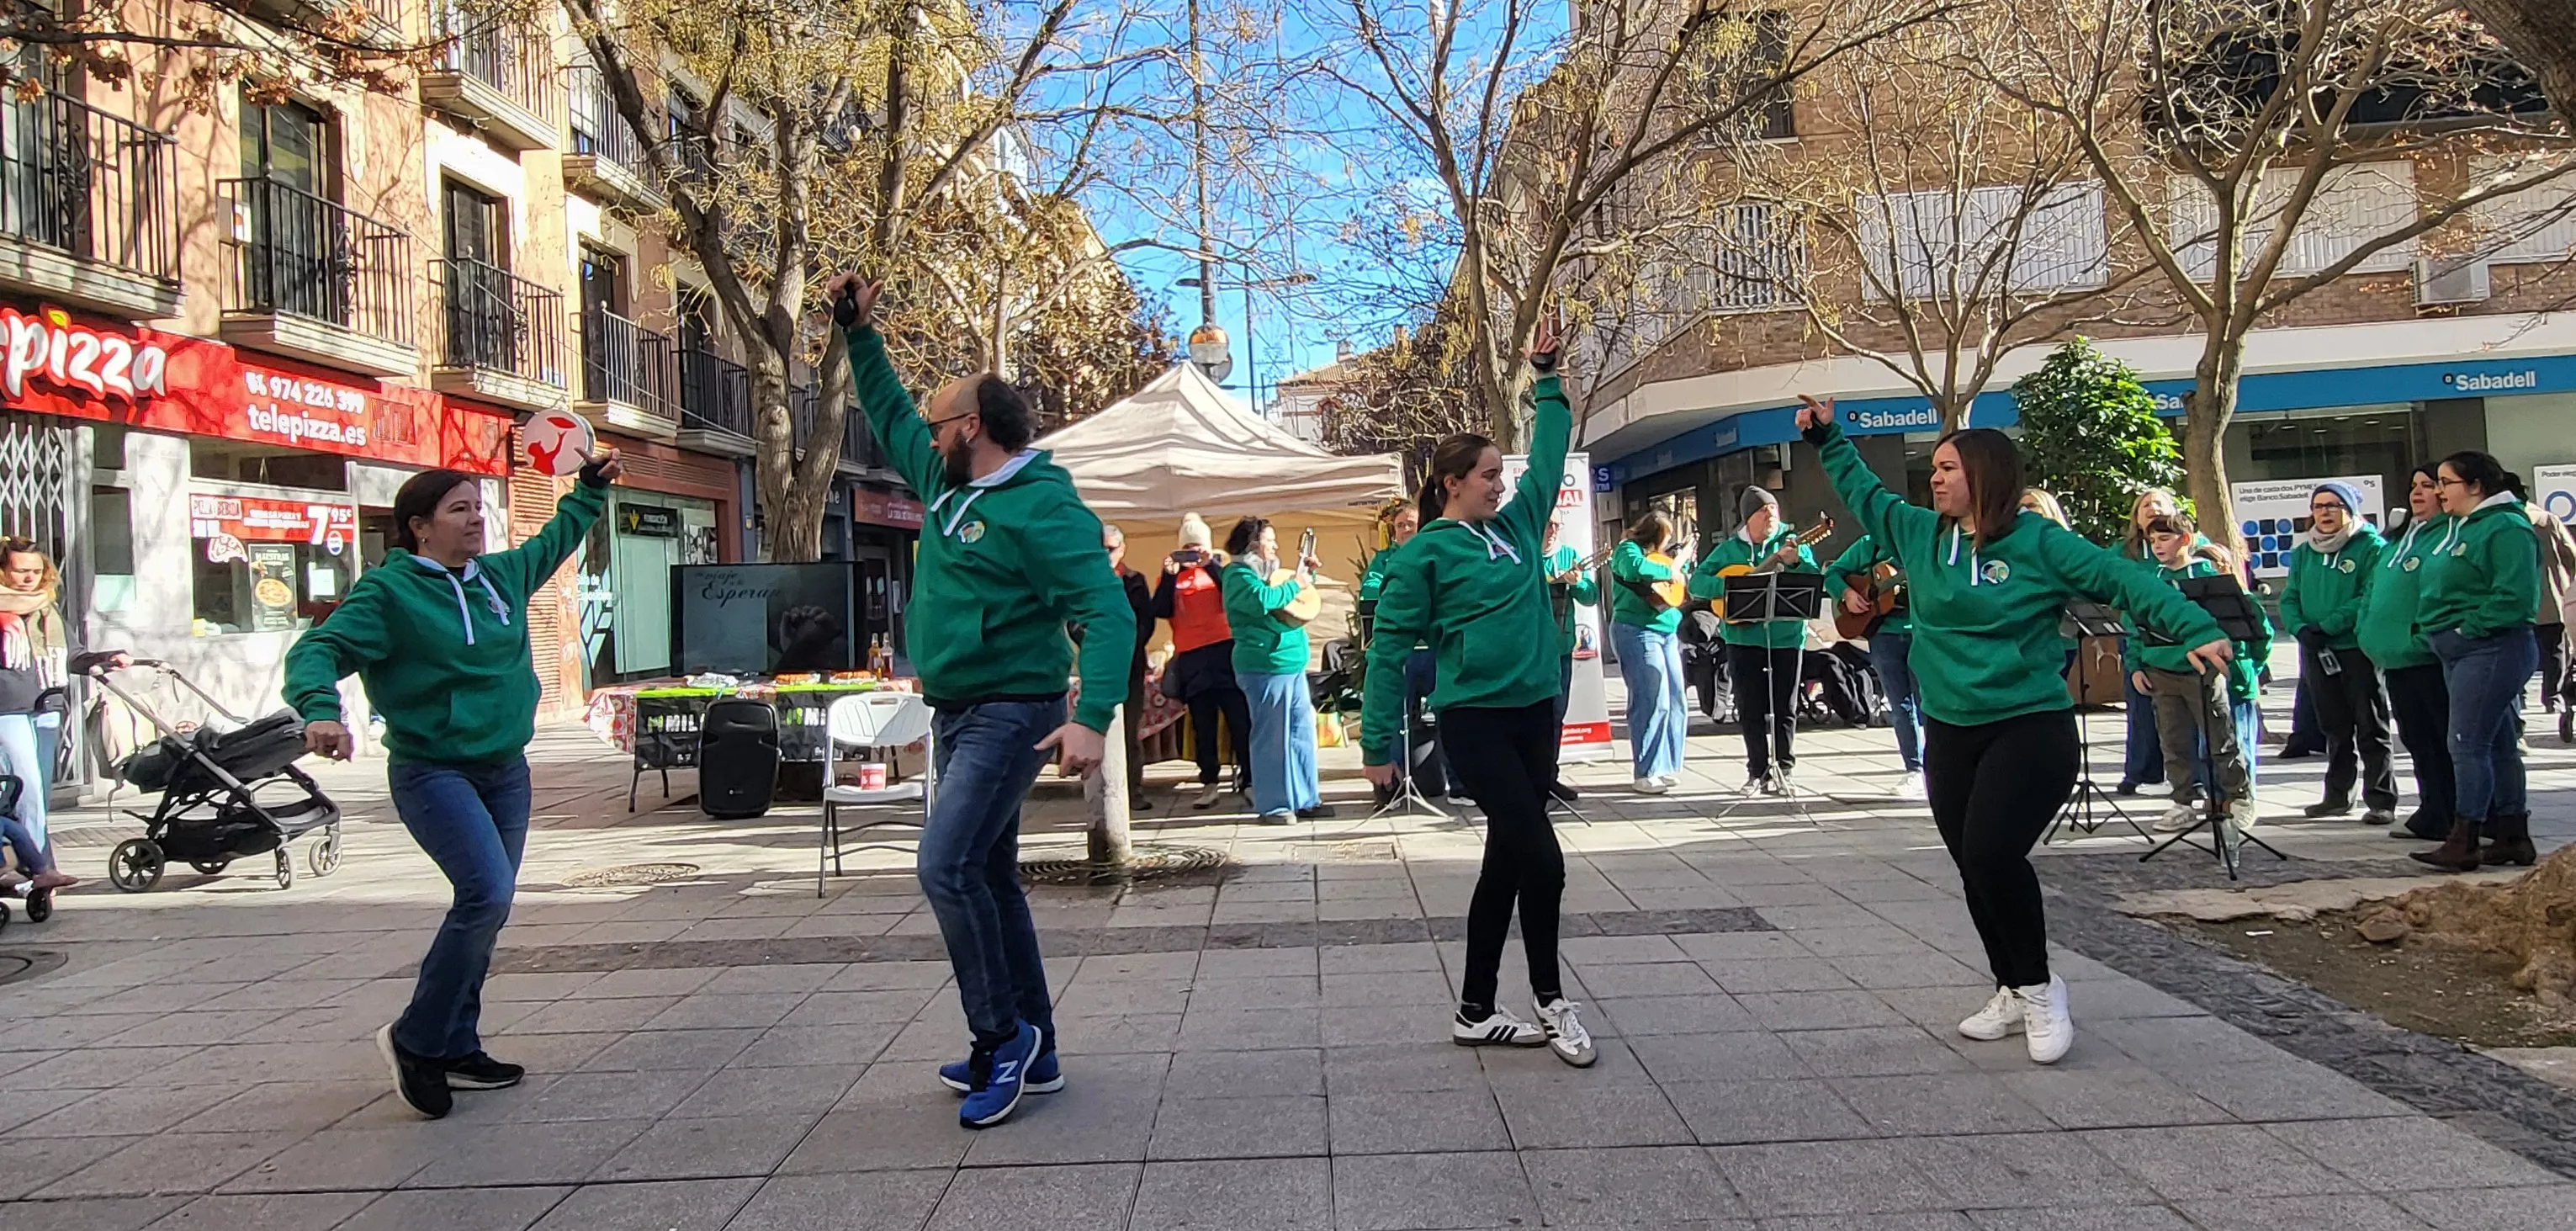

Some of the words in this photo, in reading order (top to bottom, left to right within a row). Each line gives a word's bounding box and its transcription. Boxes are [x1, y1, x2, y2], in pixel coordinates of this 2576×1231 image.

[0, 308, 167, 398] pizza
[269, 375, 303, 404] 974
[303, 382, 335, 409] 226
[336, 389, 365, 415] 399
[2454, 370, 2536, 391] Sabadell
[247, 402, 368, 447] telepizza.es
[1858, 407, 1938, 429] Sabadell
